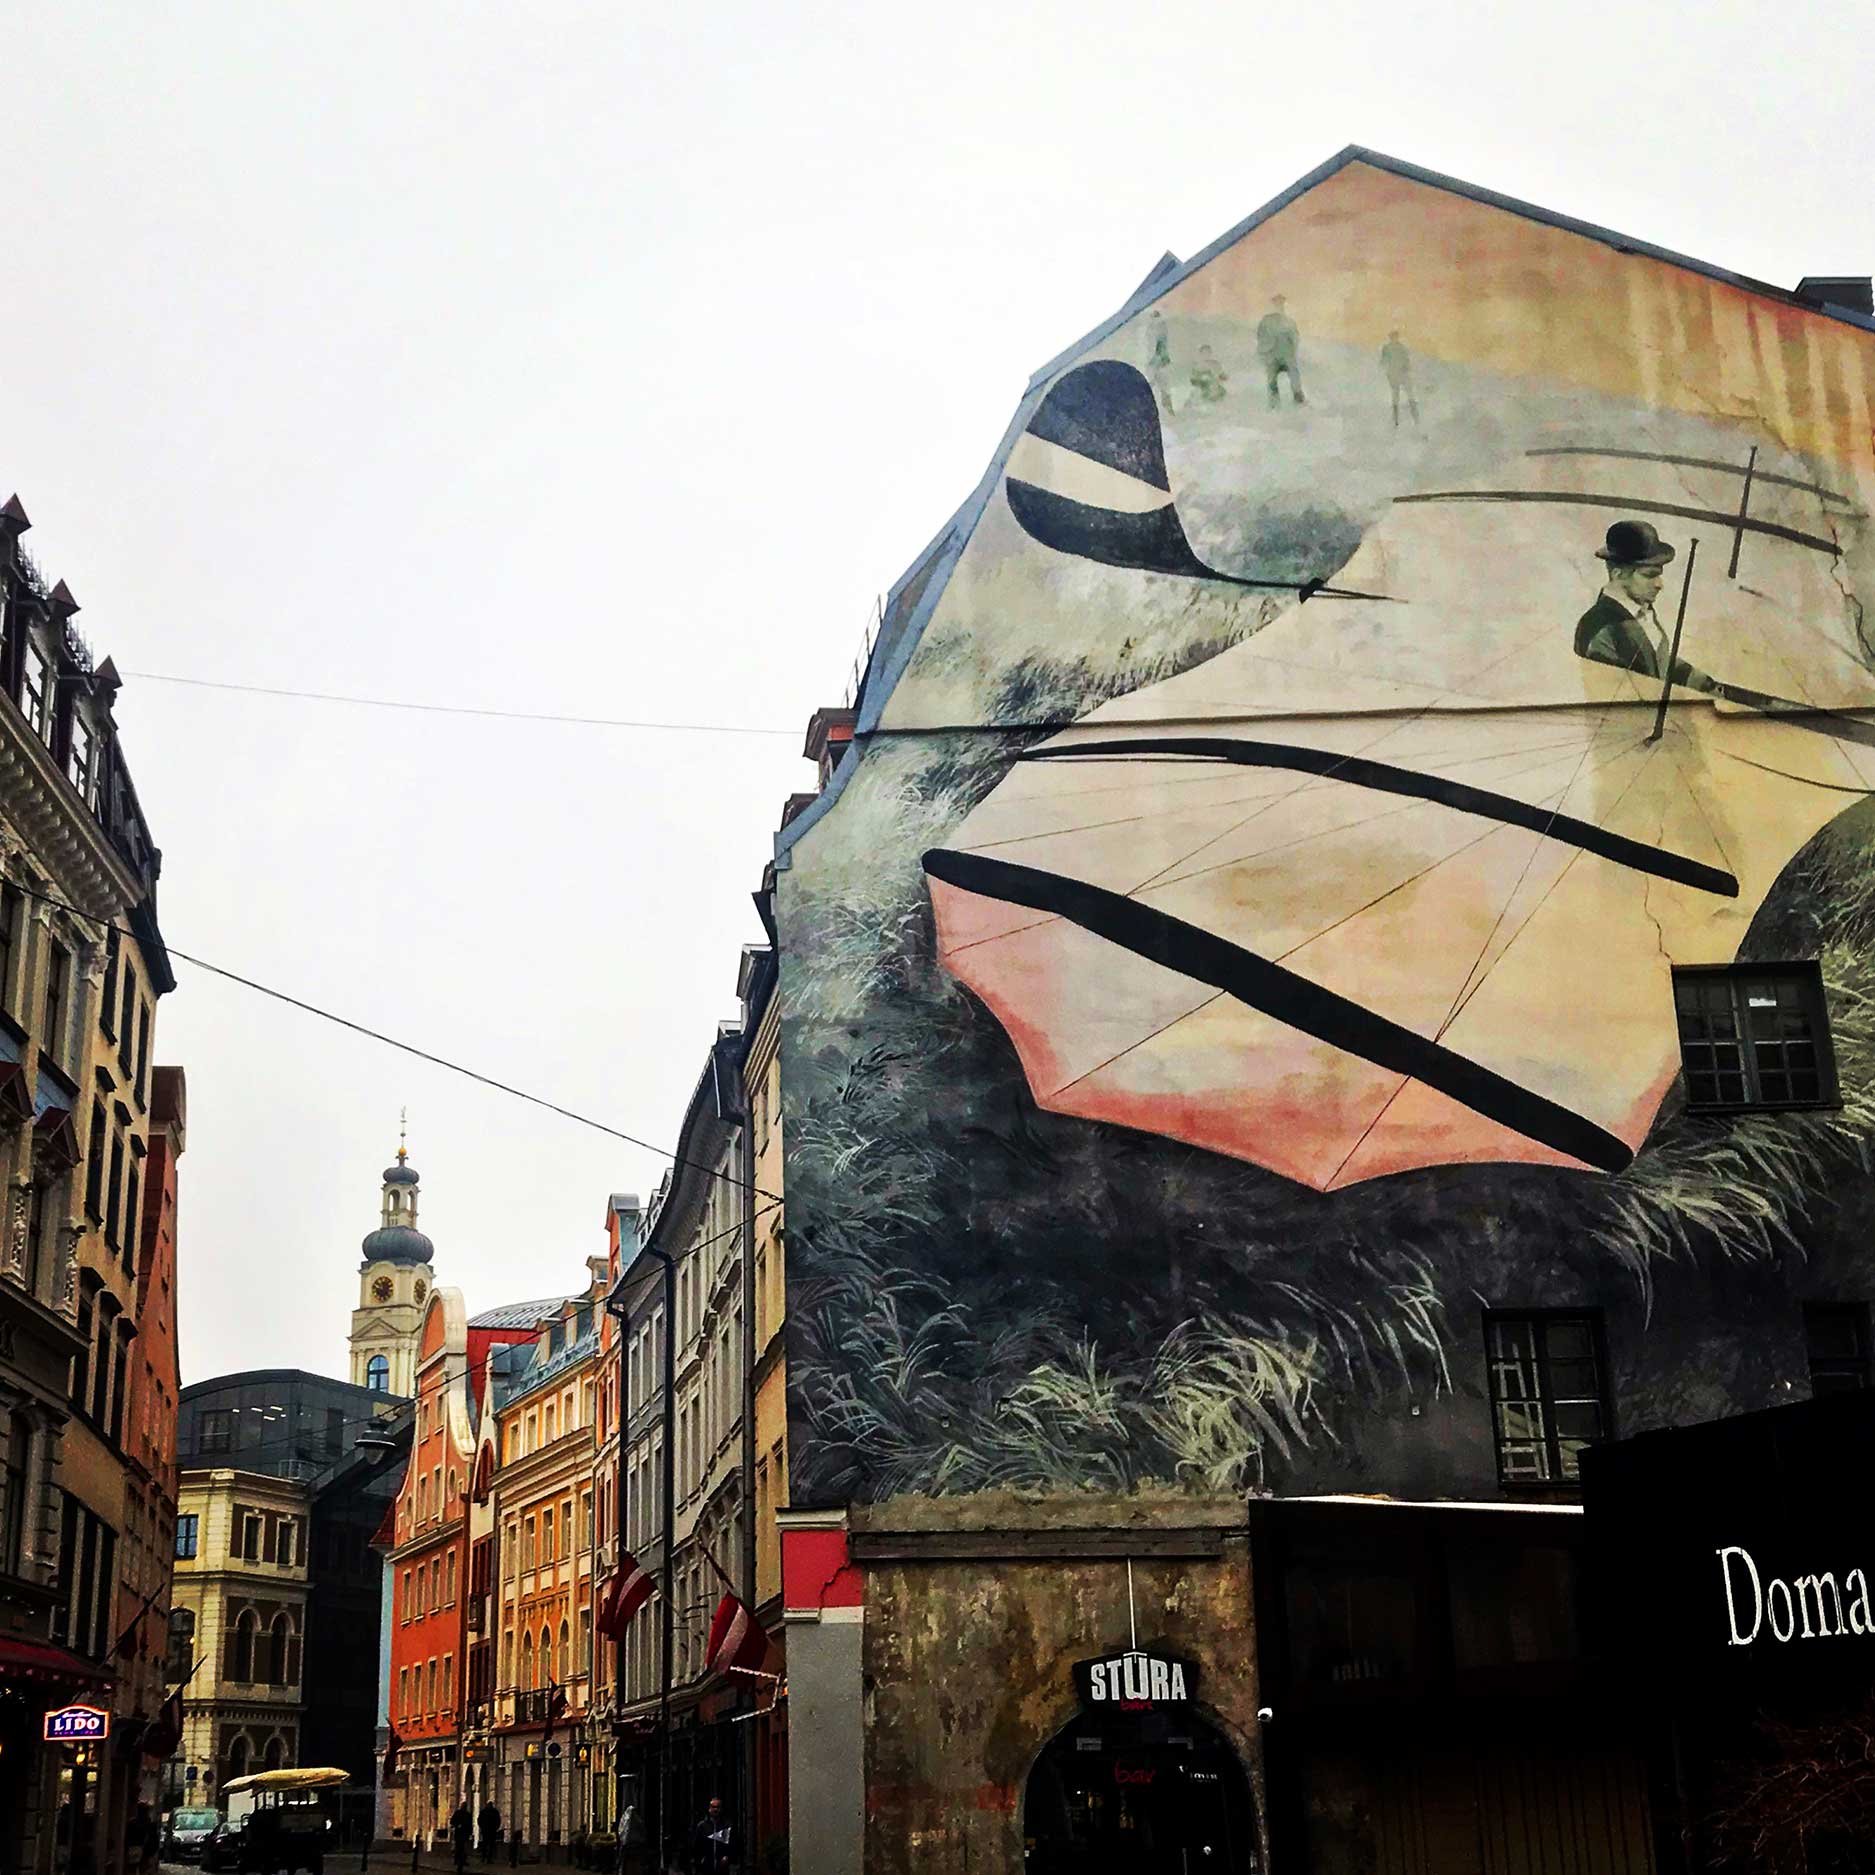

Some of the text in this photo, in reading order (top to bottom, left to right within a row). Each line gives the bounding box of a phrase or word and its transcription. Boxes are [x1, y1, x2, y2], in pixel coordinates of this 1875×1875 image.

[1715, 1546, 1875, 1645] Doma
[1090, 1651, 1187, 1701] STŪRA
[53, 1717, 100, 1731] LIDO
